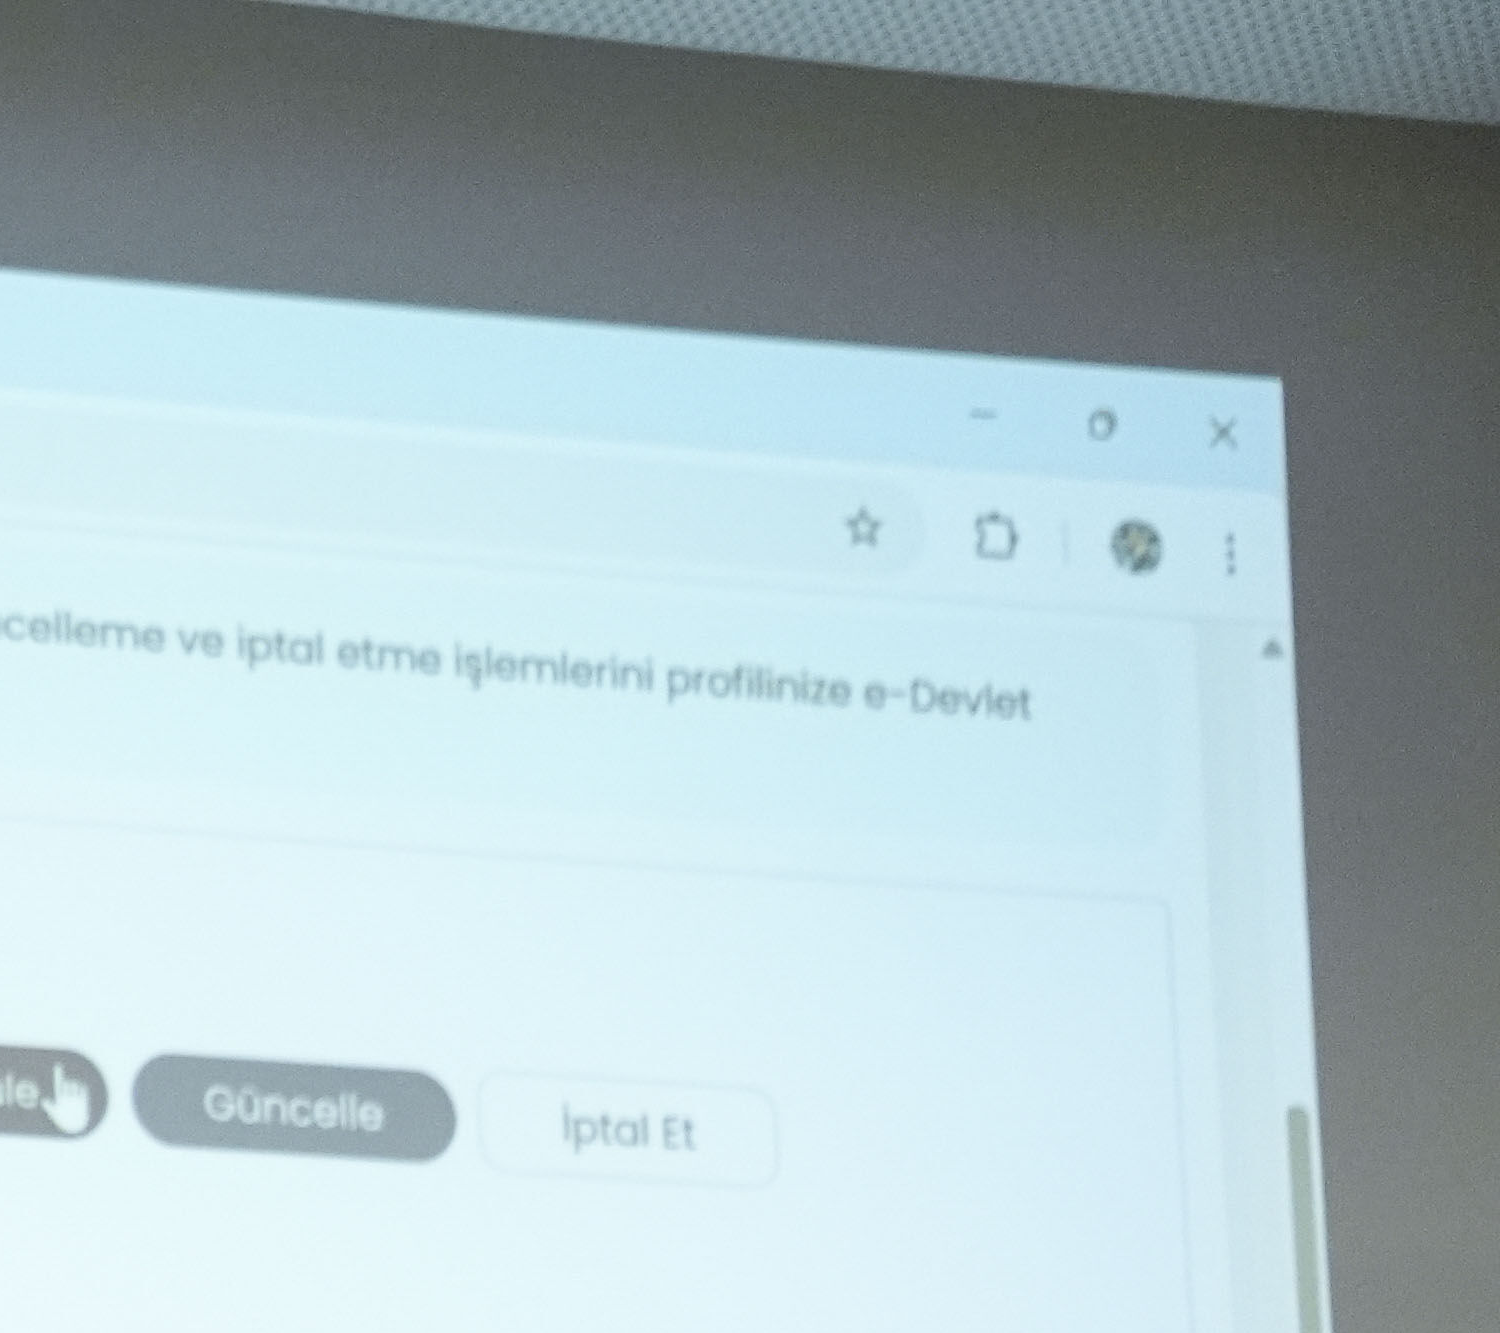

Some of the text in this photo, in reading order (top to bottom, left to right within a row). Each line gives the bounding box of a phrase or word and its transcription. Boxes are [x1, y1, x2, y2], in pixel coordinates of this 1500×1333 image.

[177, 624, 226, 659] ve
[235, 622, 326, 672] iptal
[335, 638, 443, 678] etme
[453, 641, 656, 692] işlemlerini
[666, 660, 853, 707] profilinize
[863, 676, 1033, 722] e-Devlet
[202, 1080, 386, 1134] Güncelle
[558, 1102, 697, 1156] İptal Et
